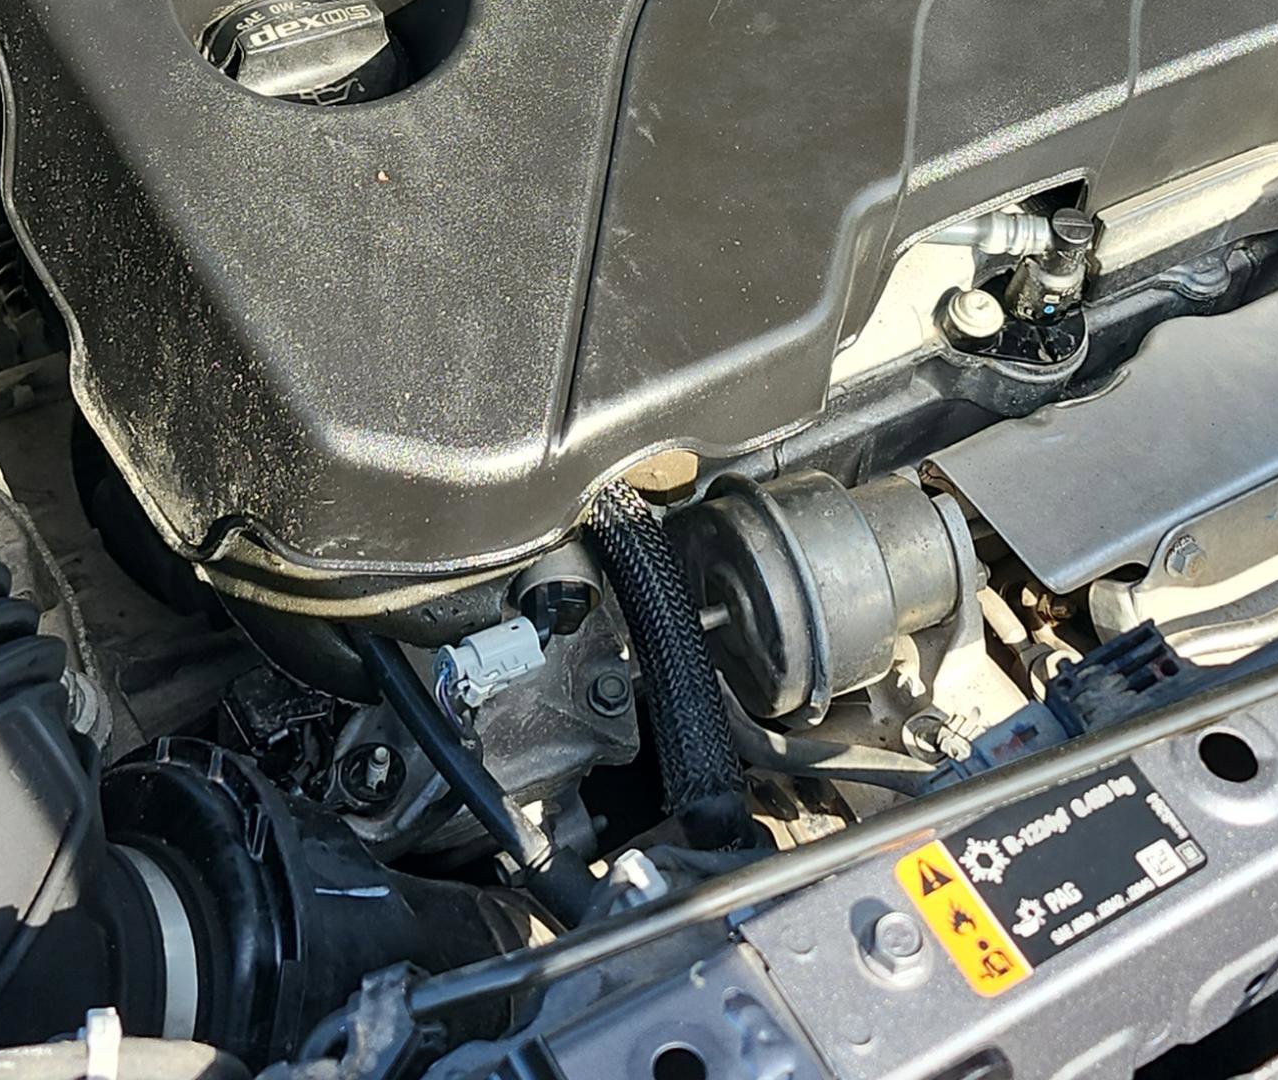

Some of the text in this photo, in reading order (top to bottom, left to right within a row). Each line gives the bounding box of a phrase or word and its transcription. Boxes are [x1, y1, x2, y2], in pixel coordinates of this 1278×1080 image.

[235, 0, 320, 32] SAE 0W-2
[248, 3, 372, 47] dexos
[1043, 881, 1083, 915] PAG
